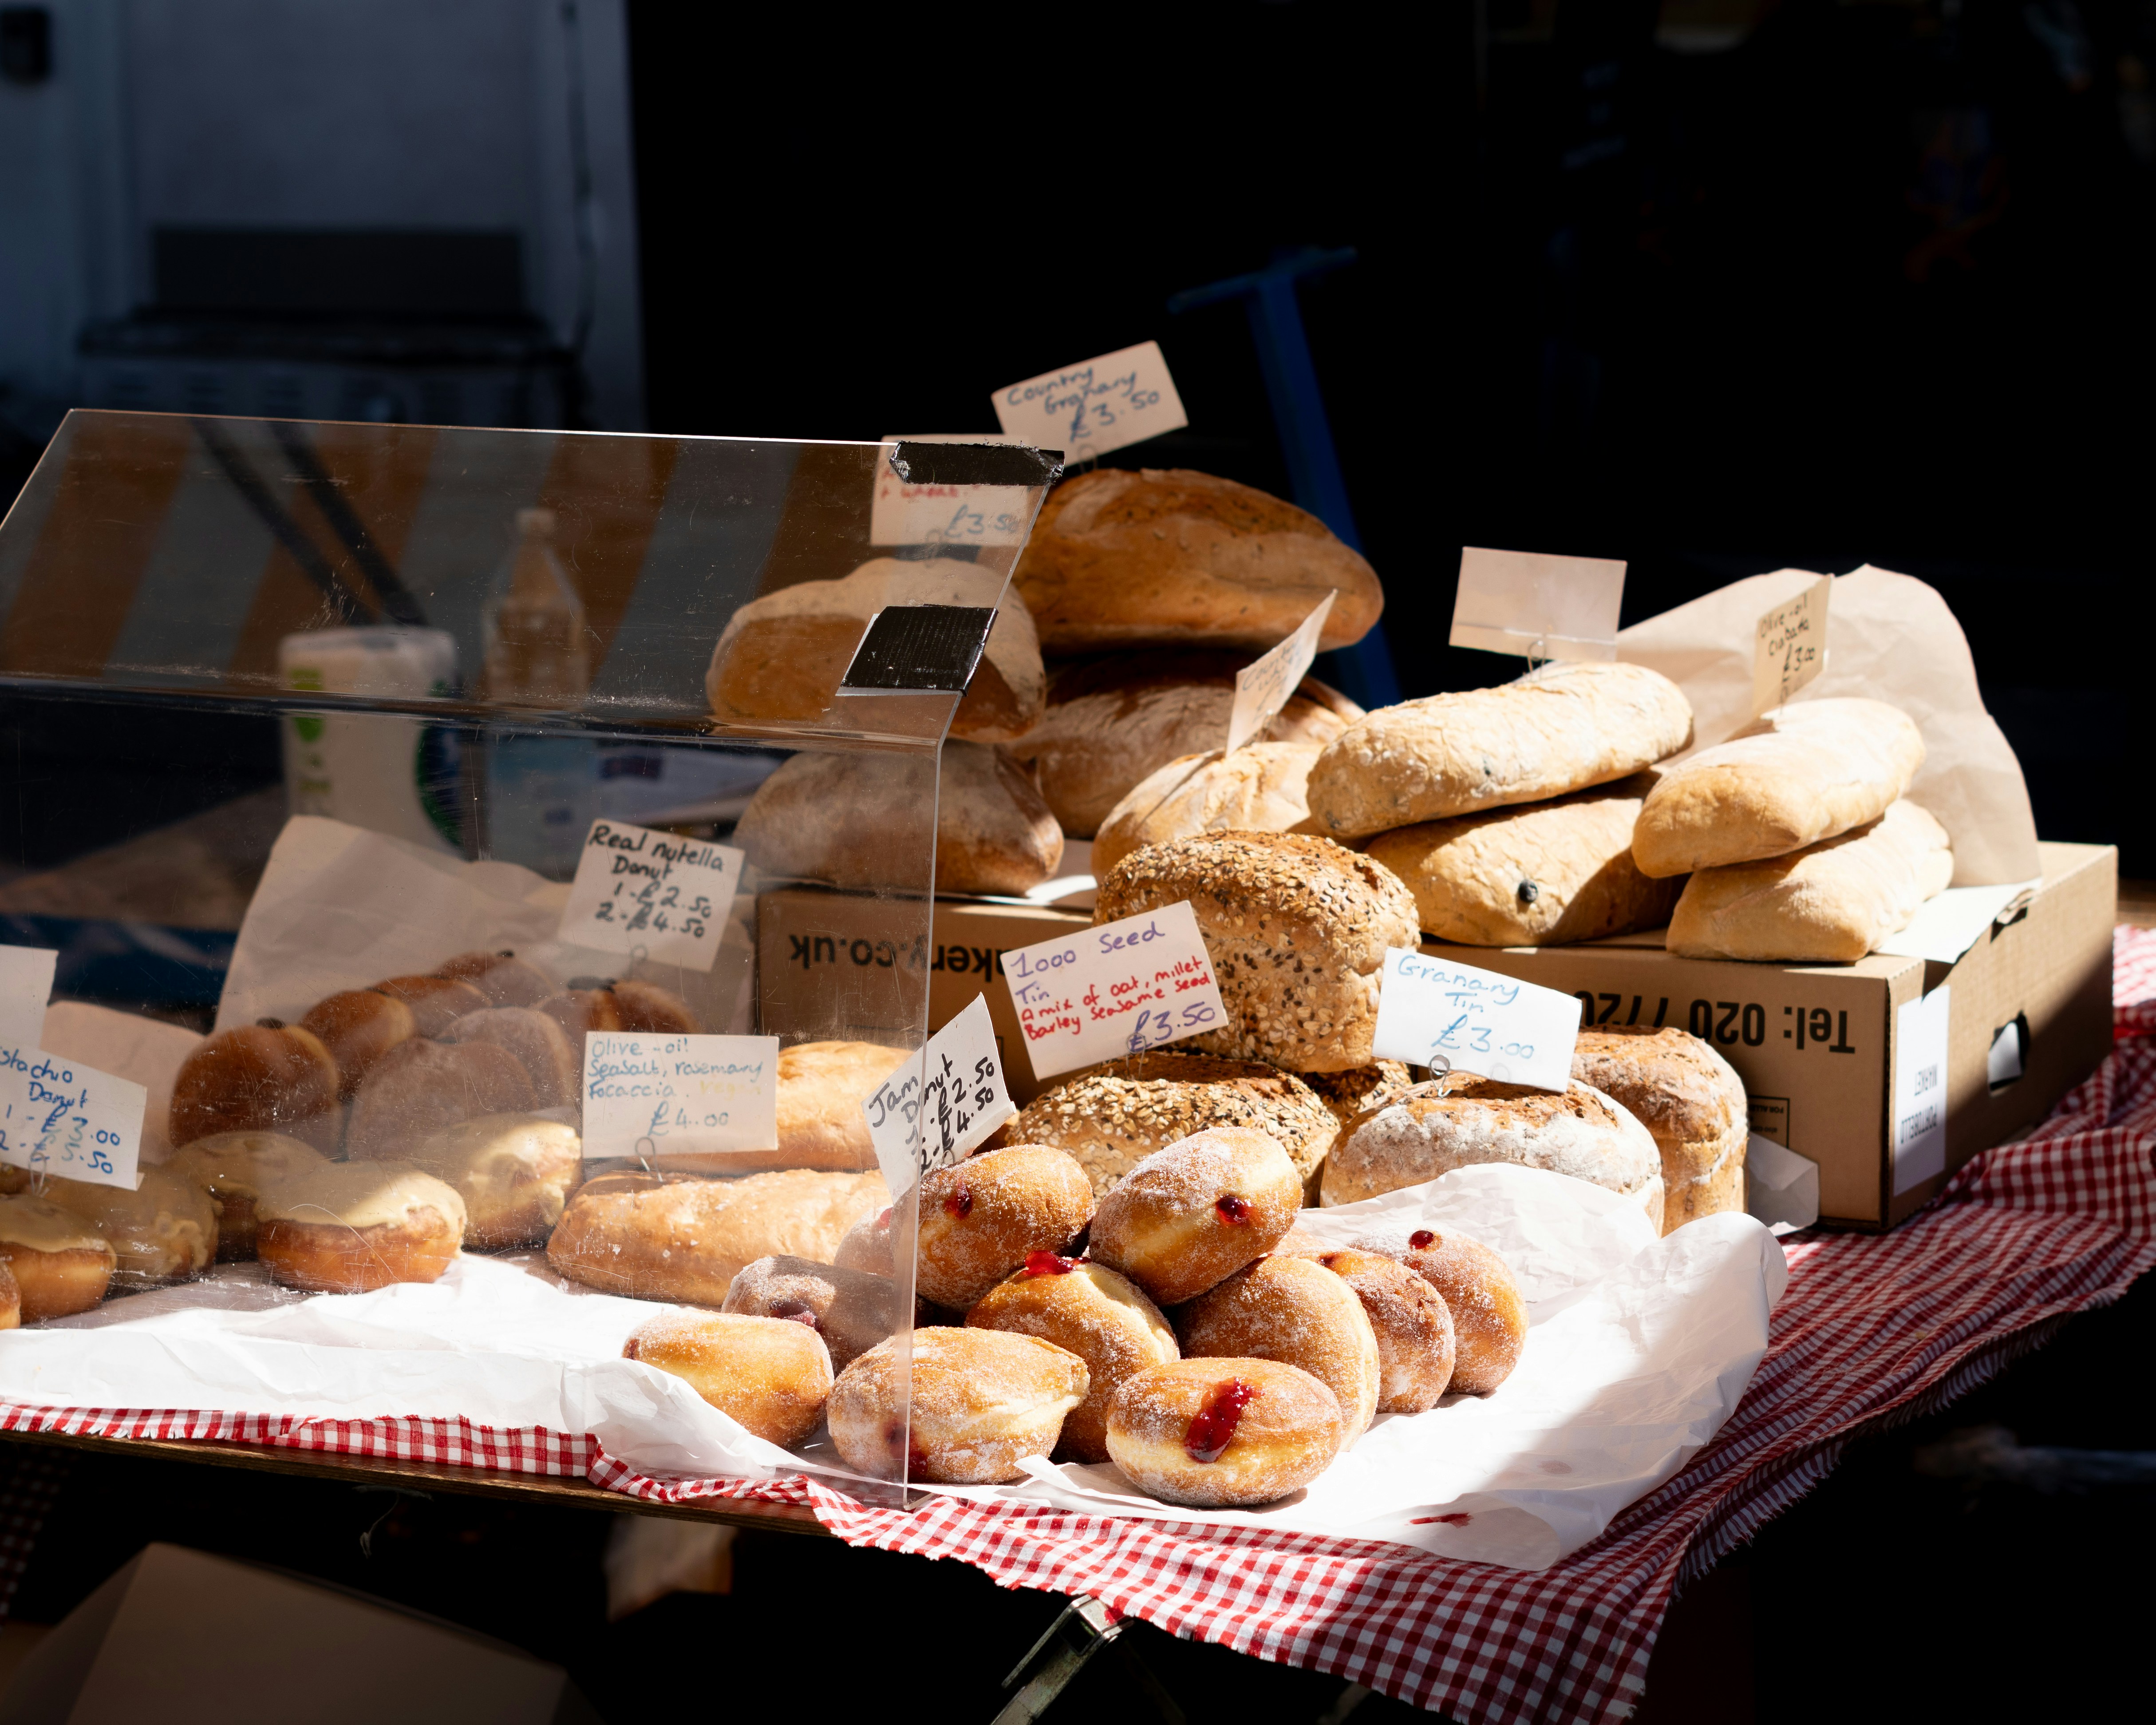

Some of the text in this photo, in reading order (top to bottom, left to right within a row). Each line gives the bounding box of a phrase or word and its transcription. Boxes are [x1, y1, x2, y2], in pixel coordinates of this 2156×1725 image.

[1007, 368, 1093, 406] Country
[1044, 372, 1136, 415] Granary
[1070, 391, 1159, 443] £3.50
[589, 825, 724, 873] Real nutella
[611, 855, 673, 880] Donut
[1010, 921, 1165, 978] 1000 Seed
[1015, 980, 1050, 1004] Tin
[1039, 999, 1074, 1017] mix
[1083, 984, 1100, 1006] of
[1155, 955, 1202, 982] millet
[1398, 954, 1520, 1006] Granary
[1445, 992, 1484, 1013] Tin
[1024, 1016, 1081, 1041] Barley
[1174, 972, 1211, 993] seed
[1129, 1001, 1216, 1052] £3.50
[1689, 999, 1765, 1047] 020
[592, 1038, 643, 1058] Olive
[1431, 1014, 1535, 1059] £3.00
[1783, 1006, 1856, 1055] Tel:
[0, 1046, 73, 1084] stachio
[675, 1061, 763, 1083] rosemary
[1914, 1064, 1938, 1096] MARKET
[29, 1081, 88, 1109] Donut
[869, 1076, 919, 1128] Jam
